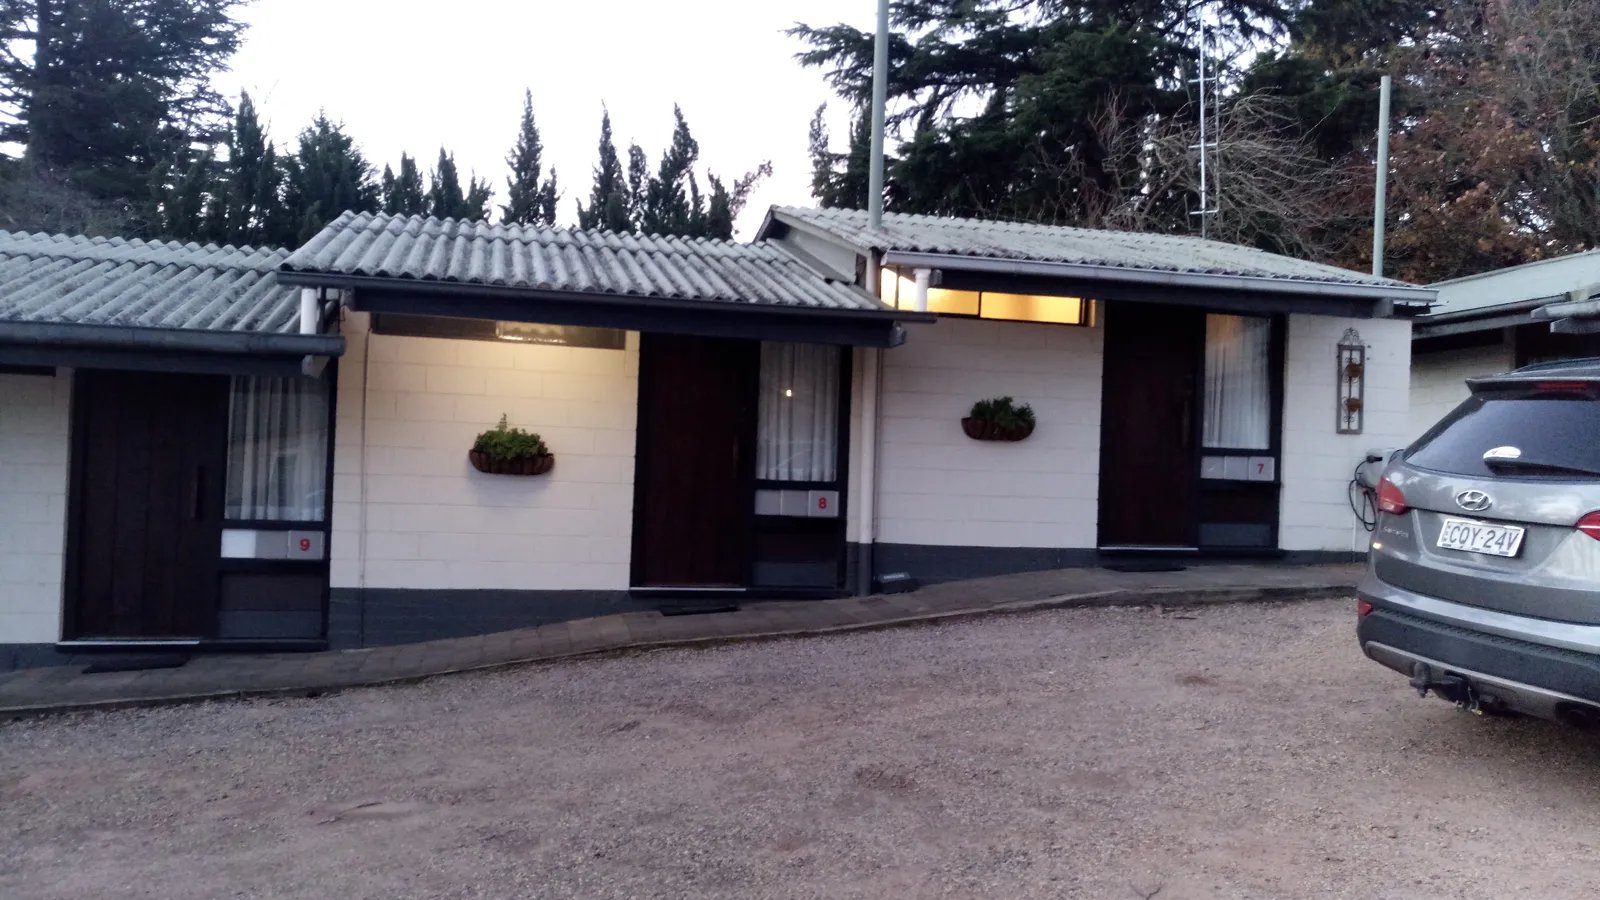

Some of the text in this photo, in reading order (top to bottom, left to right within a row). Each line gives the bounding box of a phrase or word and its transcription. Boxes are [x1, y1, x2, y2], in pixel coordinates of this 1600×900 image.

[1257, 463, 1265, 474] 7
[818, 497, 828, 510] 8
[299, 538, 311, 551] 9
